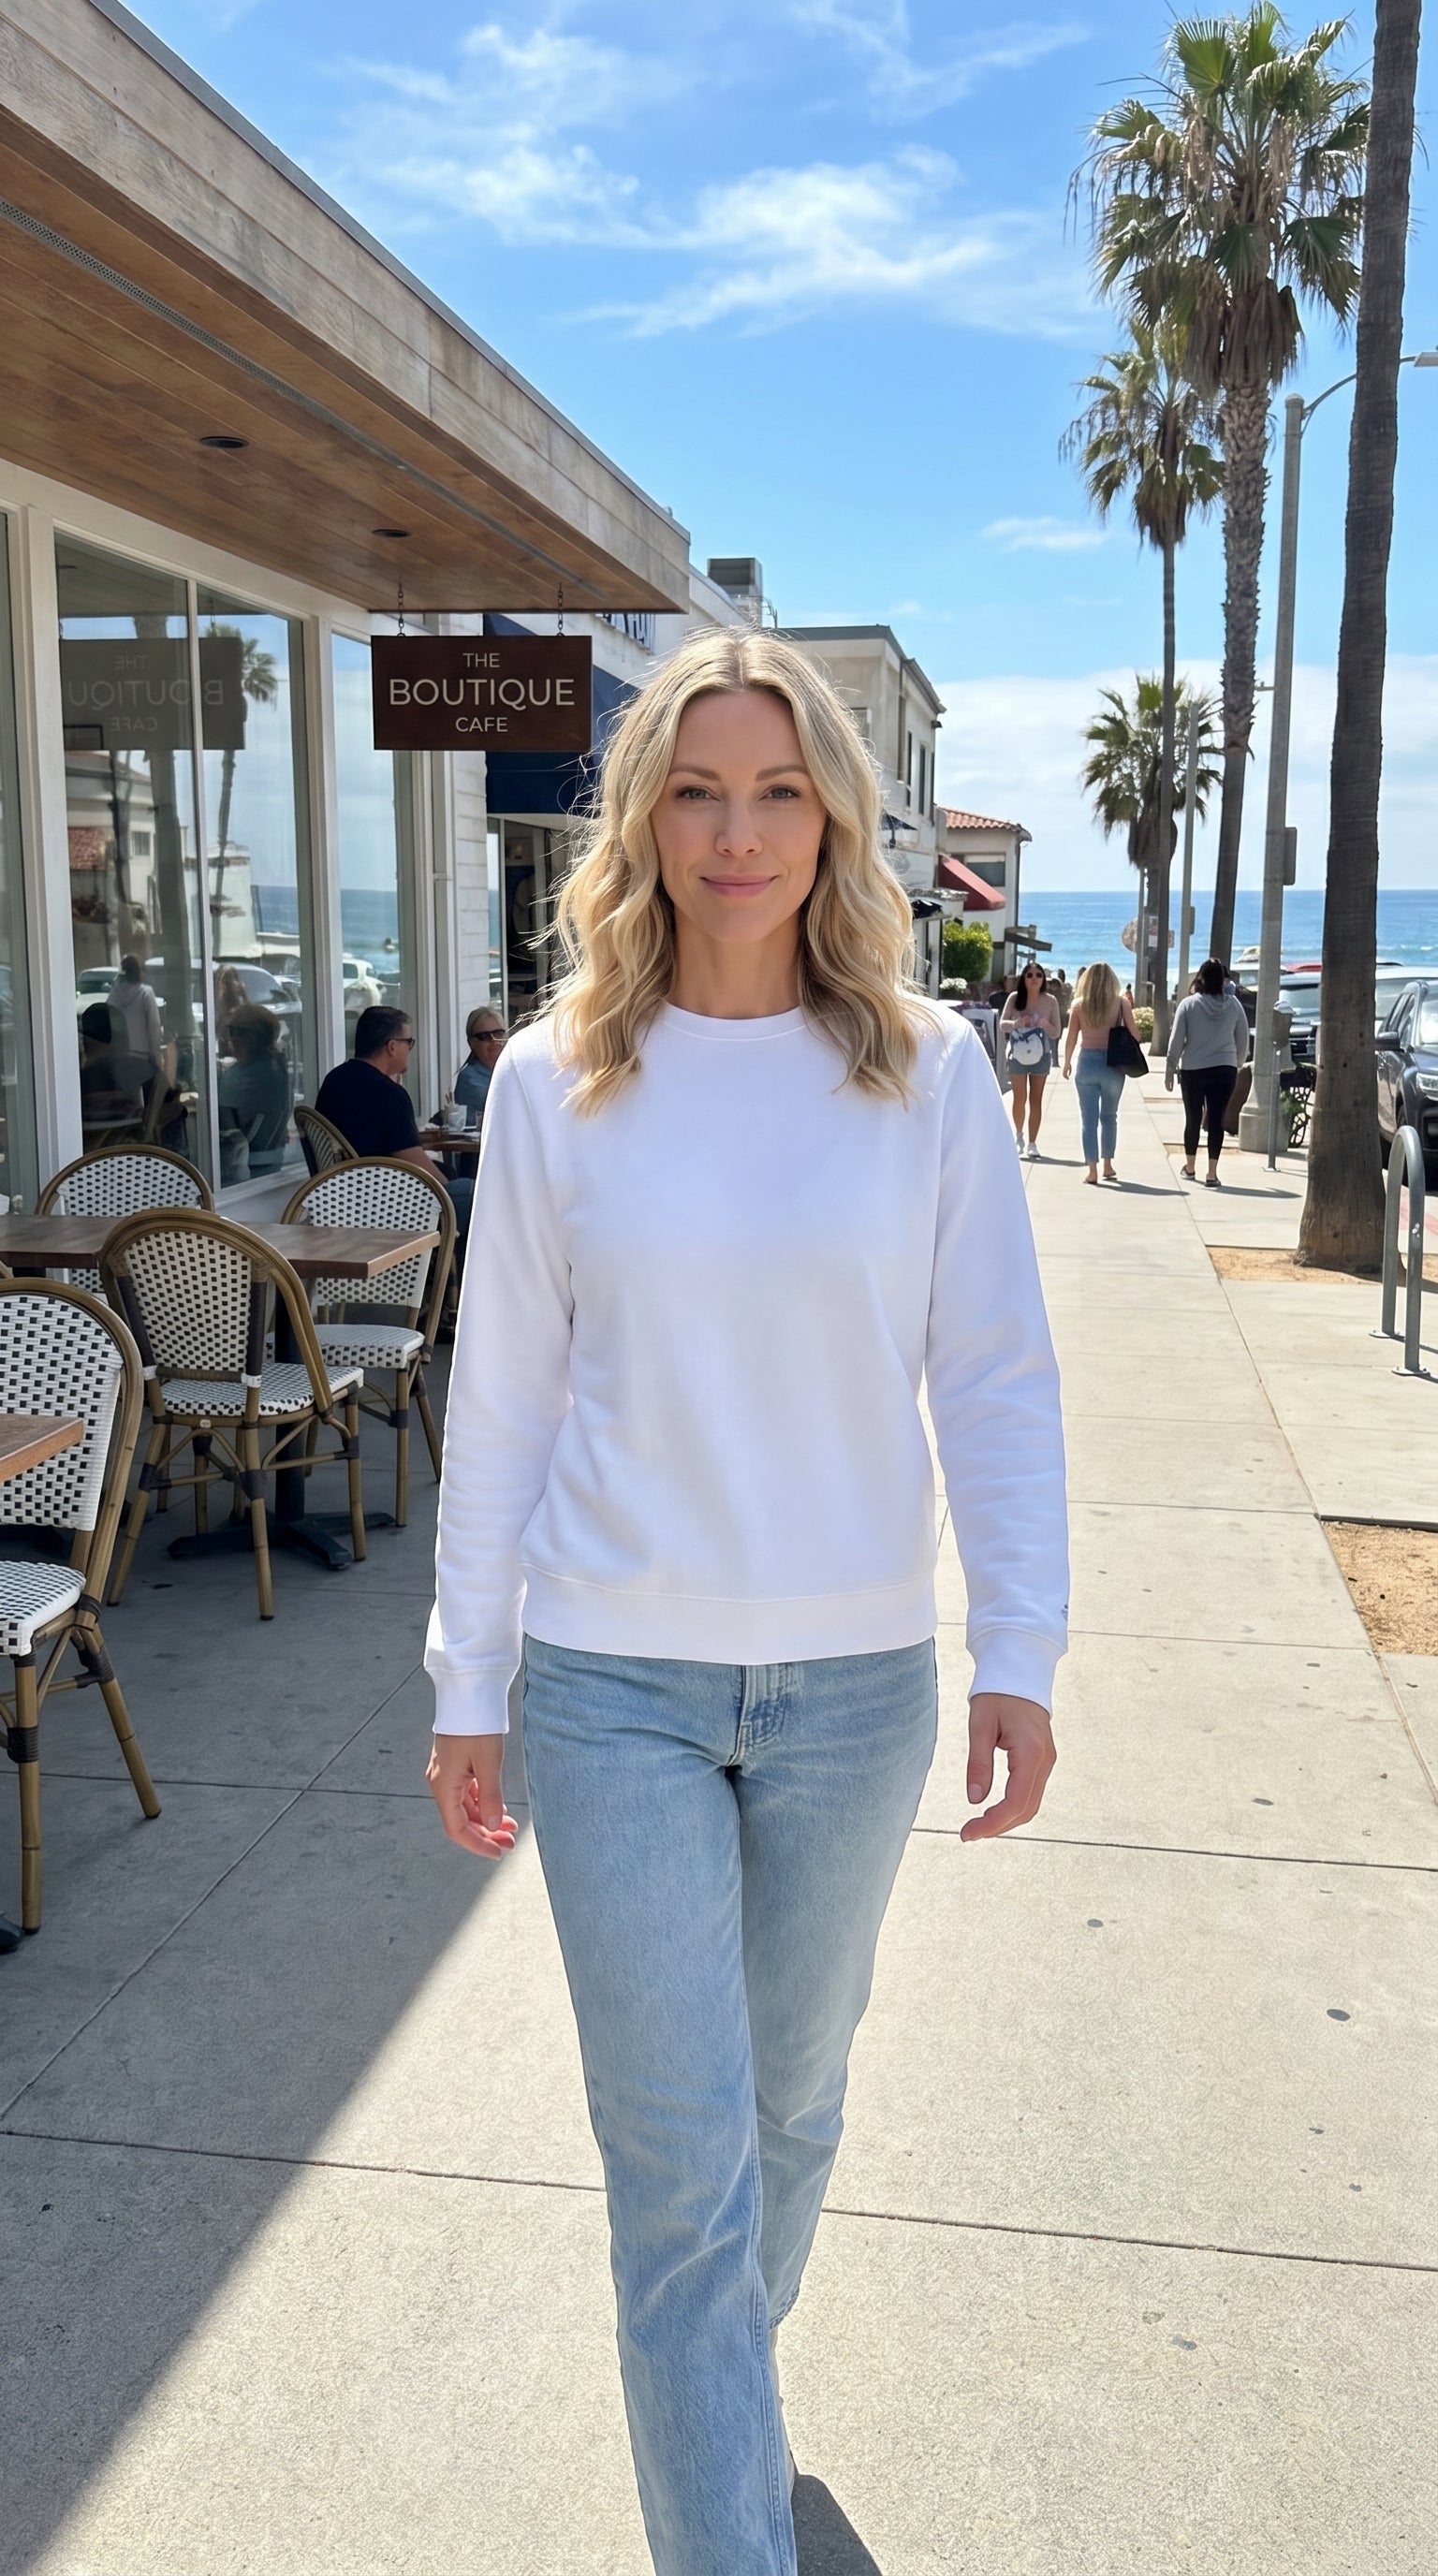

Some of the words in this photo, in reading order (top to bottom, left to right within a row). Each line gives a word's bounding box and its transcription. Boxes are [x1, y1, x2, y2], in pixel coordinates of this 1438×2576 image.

[462, 652, 501, 668] THE
[389, 679, 576, 711] BOUTIQUE
[455, 717, 508, 733] CAFE
